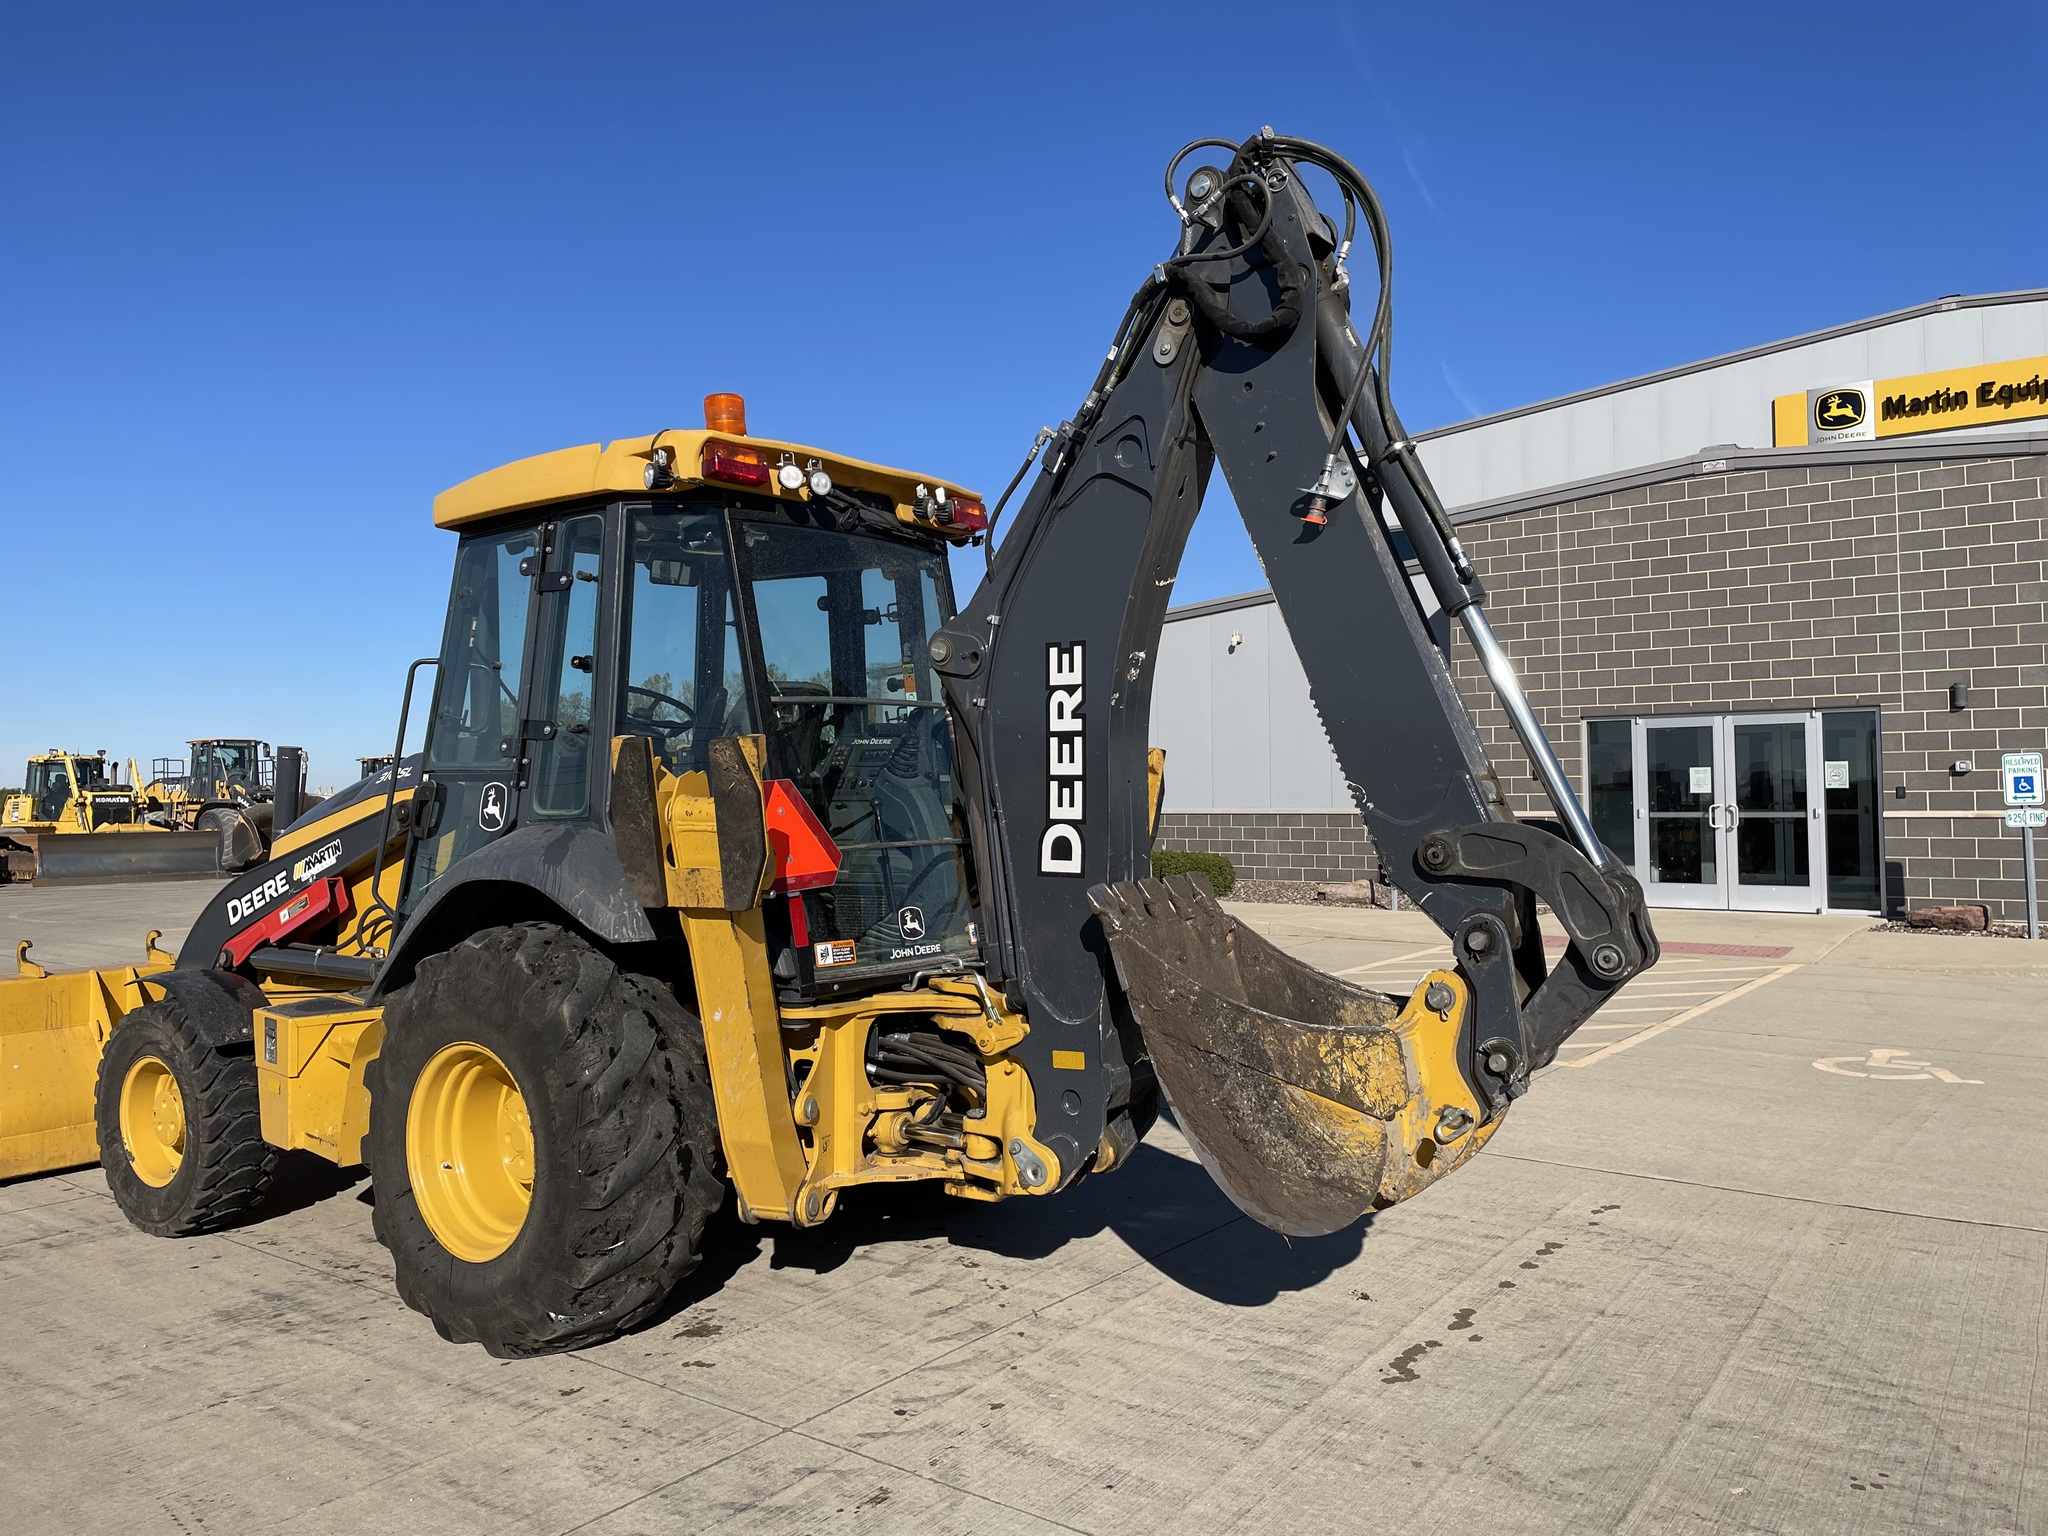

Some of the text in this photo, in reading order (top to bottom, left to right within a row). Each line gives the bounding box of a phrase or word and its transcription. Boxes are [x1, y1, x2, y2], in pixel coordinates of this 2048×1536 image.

[1883, 387, 1968, 418] Martin
[1815, 432, 1867, 443] JOHN DEERE
[1041, 645, 1083, 874] DEERE
[2005, 758, 2040, 766] RESERVED
[2029, 812, 2044, 822] FINE
[303, 840, 342, 874] MARTIN
[226, 870, 290, 926] DEERE
[889, 943, 942, 959] JOHN DEERE
